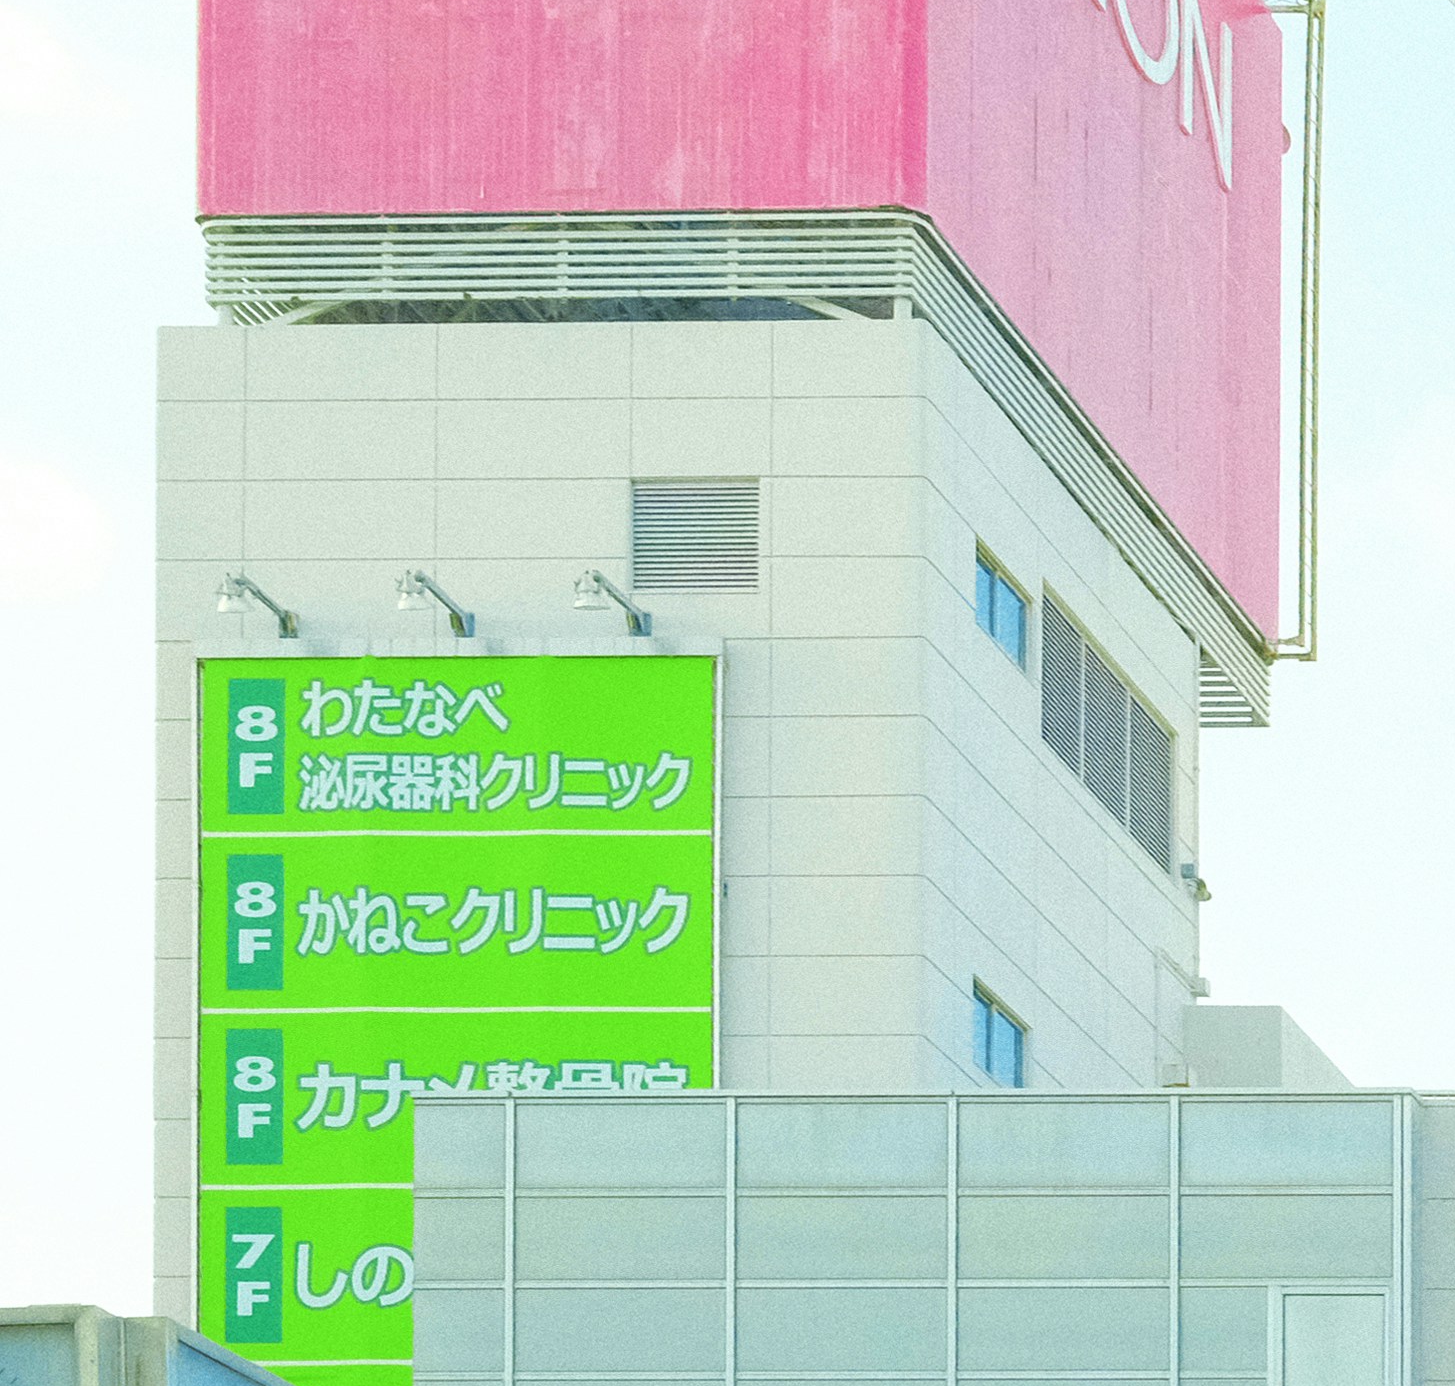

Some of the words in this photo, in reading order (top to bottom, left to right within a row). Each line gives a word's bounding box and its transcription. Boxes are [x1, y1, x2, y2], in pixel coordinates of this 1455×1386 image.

[300, 679, 510, 737] わたなべ
[297, 752, 691, 812] 泌尿器科クリニック
[296, 886, 689, 955] かねこクリニック
